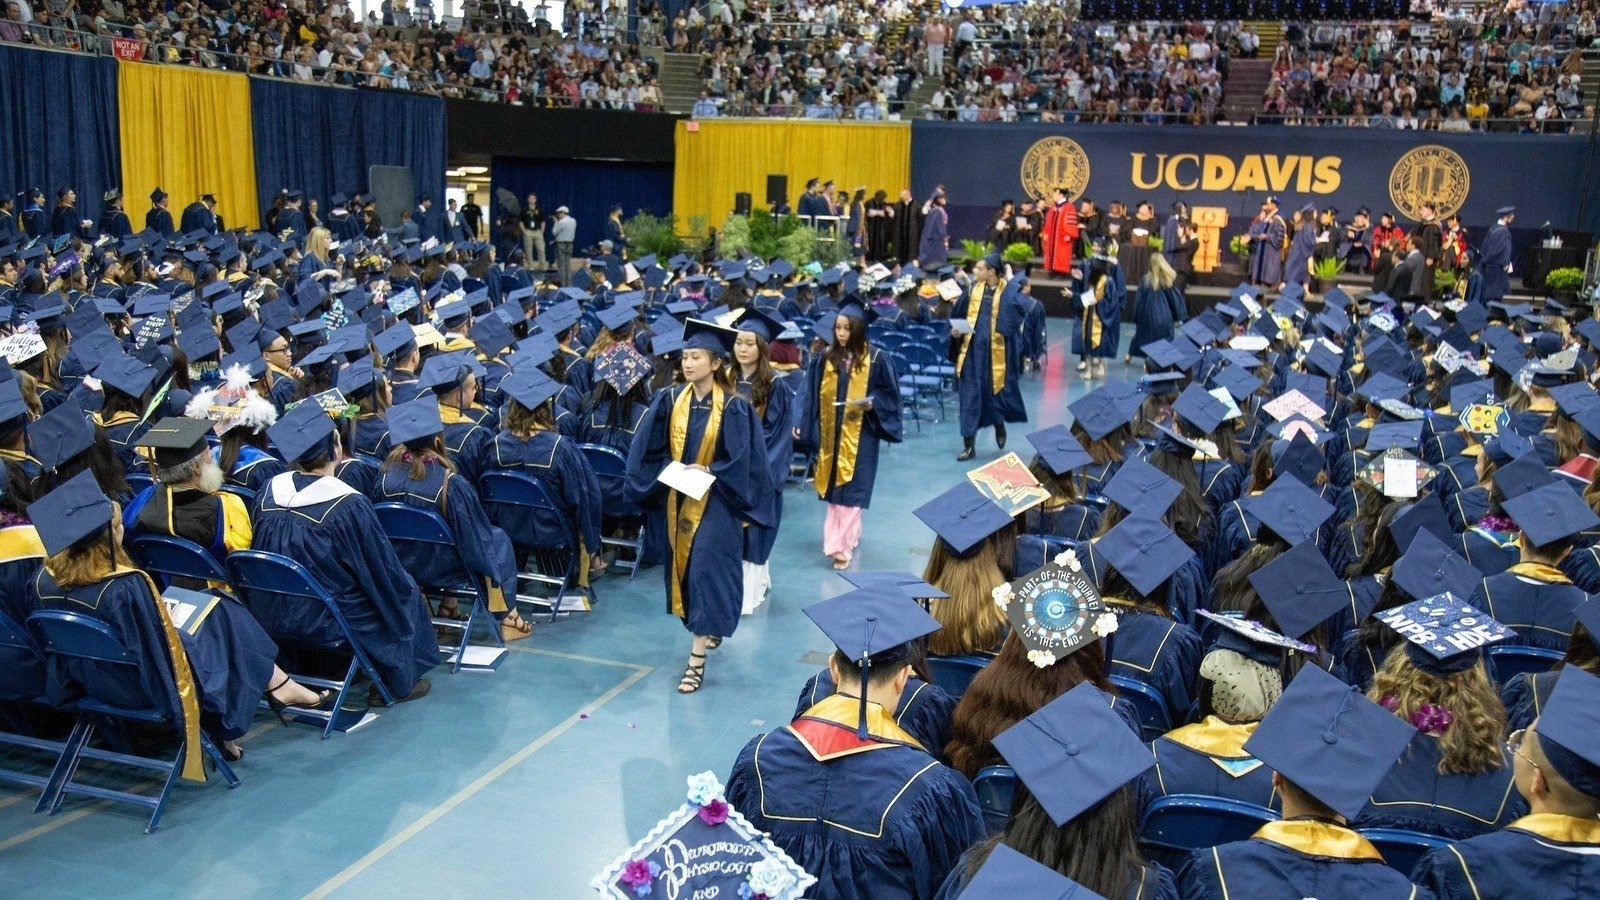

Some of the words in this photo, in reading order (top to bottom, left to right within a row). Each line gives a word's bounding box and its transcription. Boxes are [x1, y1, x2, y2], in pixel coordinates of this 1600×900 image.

[116, 40, 130, 49] NOT
[130, 43, 140, 51] AN
[1019, 577, 1037, 598] PART
[1040, 570, 1051, 580] OF
[1057, 570, 1071, 581] THE
[1023, 626, 1035, 637] IS
[1039, 636, 1054, 648] THE
[1062, 636, 1079, 648] END
[1382, 614, 1437, 644] NPB
[1444, 624, 1504, 650] HDE
